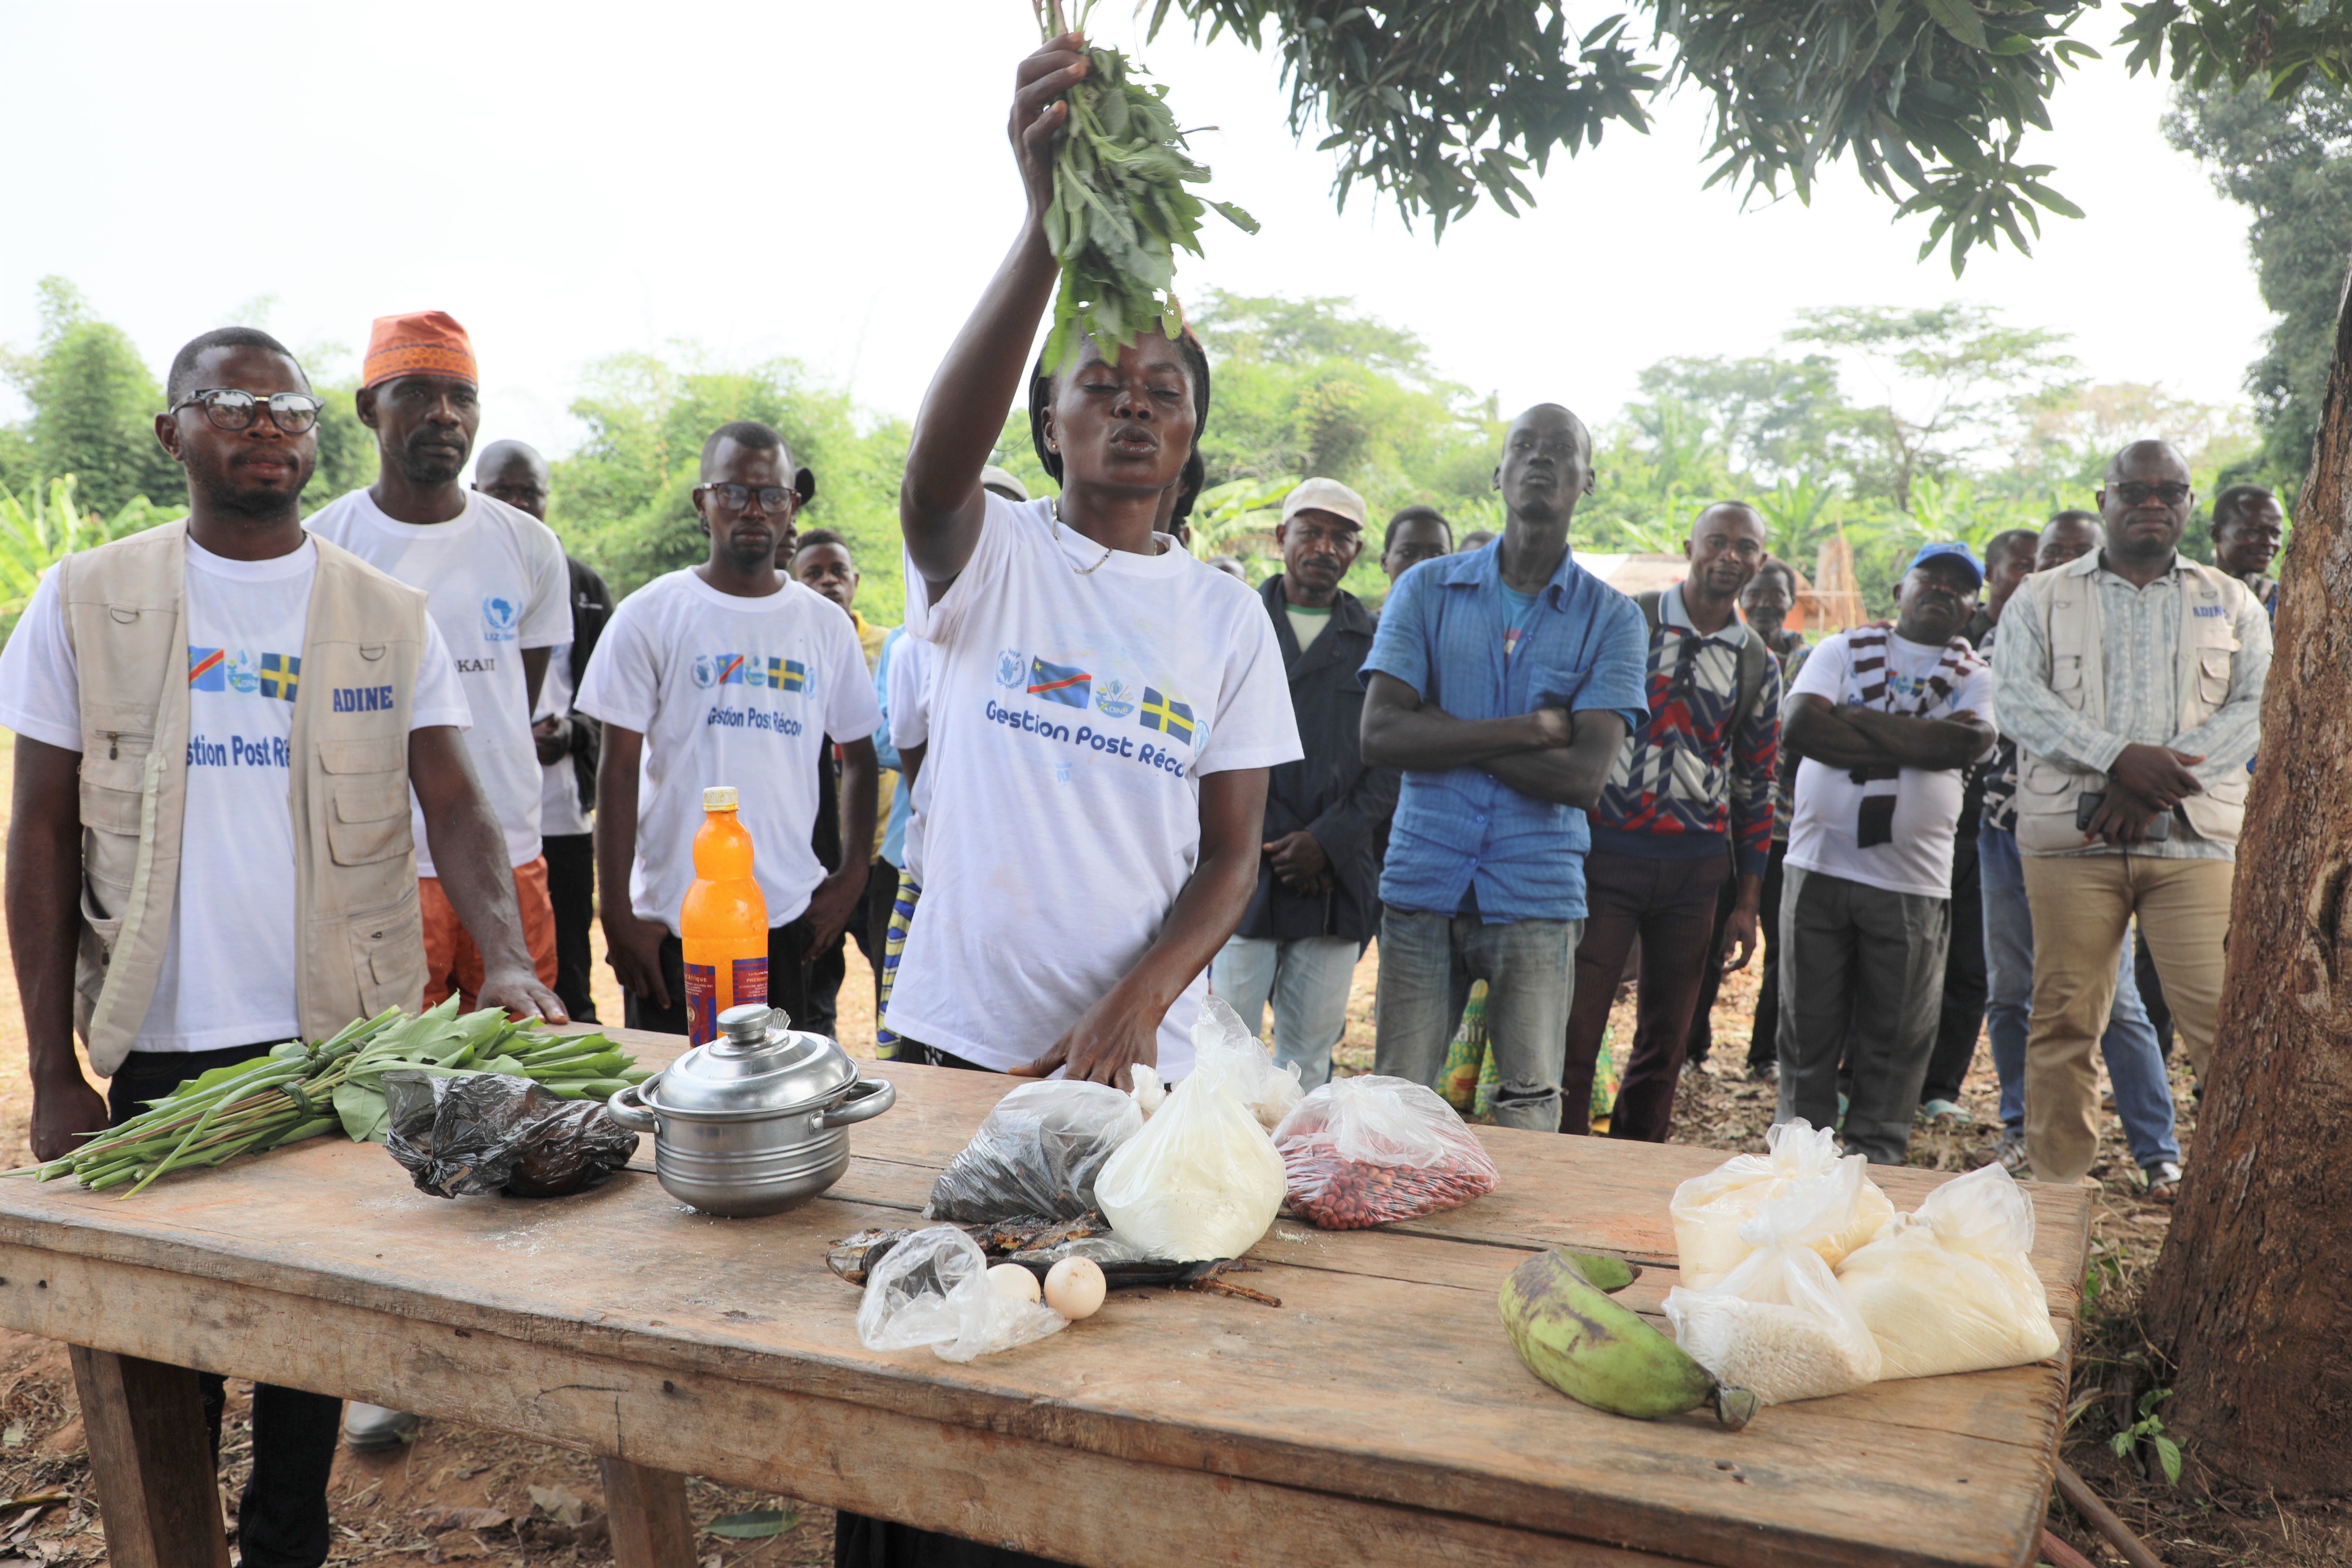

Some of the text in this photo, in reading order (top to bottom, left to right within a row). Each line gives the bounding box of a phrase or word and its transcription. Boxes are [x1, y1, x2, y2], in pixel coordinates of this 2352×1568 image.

[333, 685, 393, 712] ADINE
[188, 734, 227, 767] stion
[231, 736, 271, 766] Post
[986, 700, 1186, 778] Gestion Post Réco
